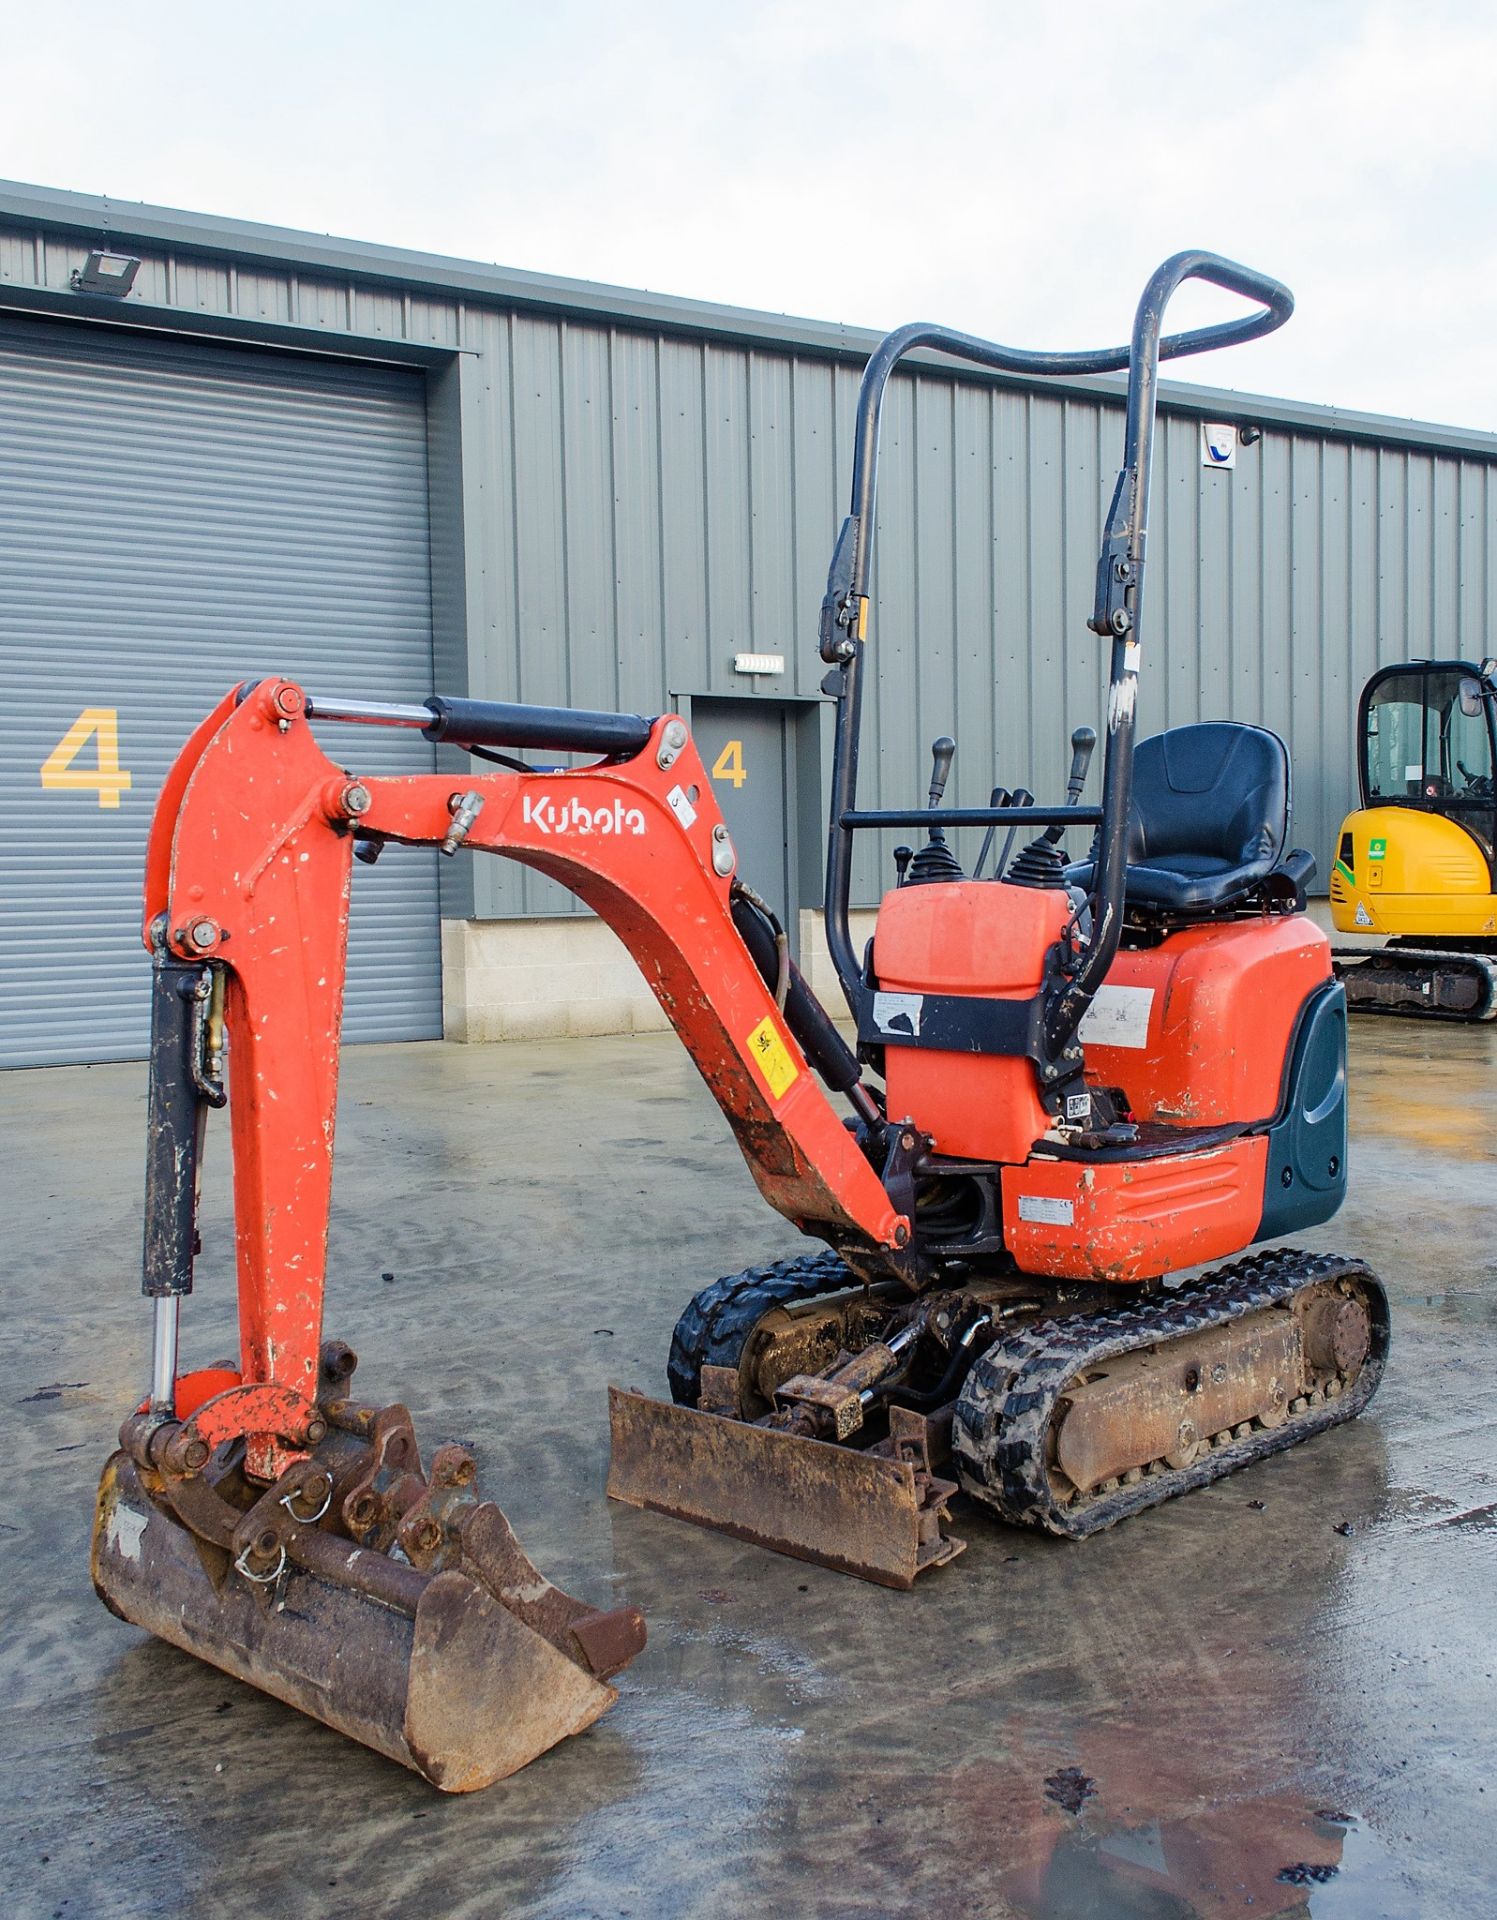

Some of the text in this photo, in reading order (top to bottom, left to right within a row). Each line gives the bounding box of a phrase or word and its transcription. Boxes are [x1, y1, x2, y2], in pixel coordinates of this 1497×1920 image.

[40, 708, 132, 809] 4
[712, 740, 747, 788] 4
[522, 795, 645, 835] Kubota
